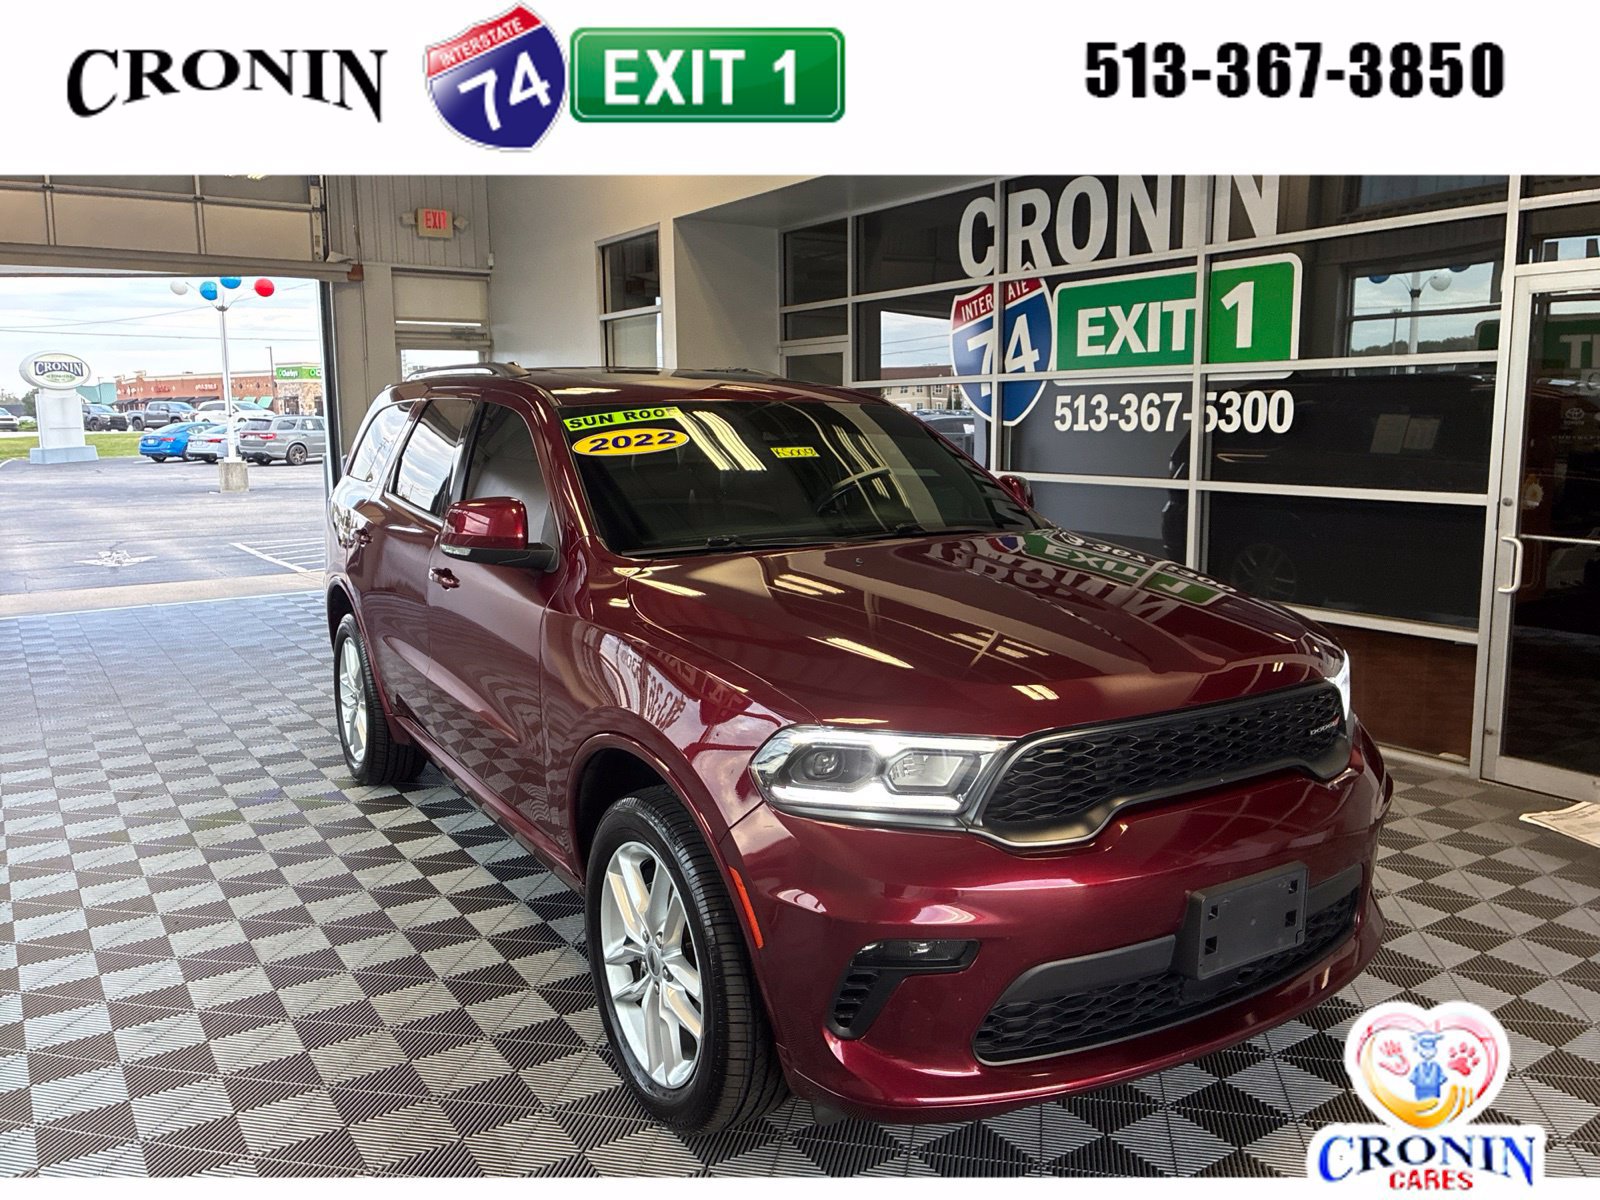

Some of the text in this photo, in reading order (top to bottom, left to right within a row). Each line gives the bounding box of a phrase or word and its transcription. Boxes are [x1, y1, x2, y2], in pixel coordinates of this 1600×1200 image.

[424, 208, 448, 230] EXIT
[958, 174, 1280, 279] CRONIN
[1077, 280, 1256, 358] EXIT 1
[35, 361, 82, 376] CRONIN
[966, 313, 1040, 398] 74
[569, 413, 614, 429] SUN
[1053, 389, 1295, 434] 513-367-5300
[588, 431, 677, 453] 2022
